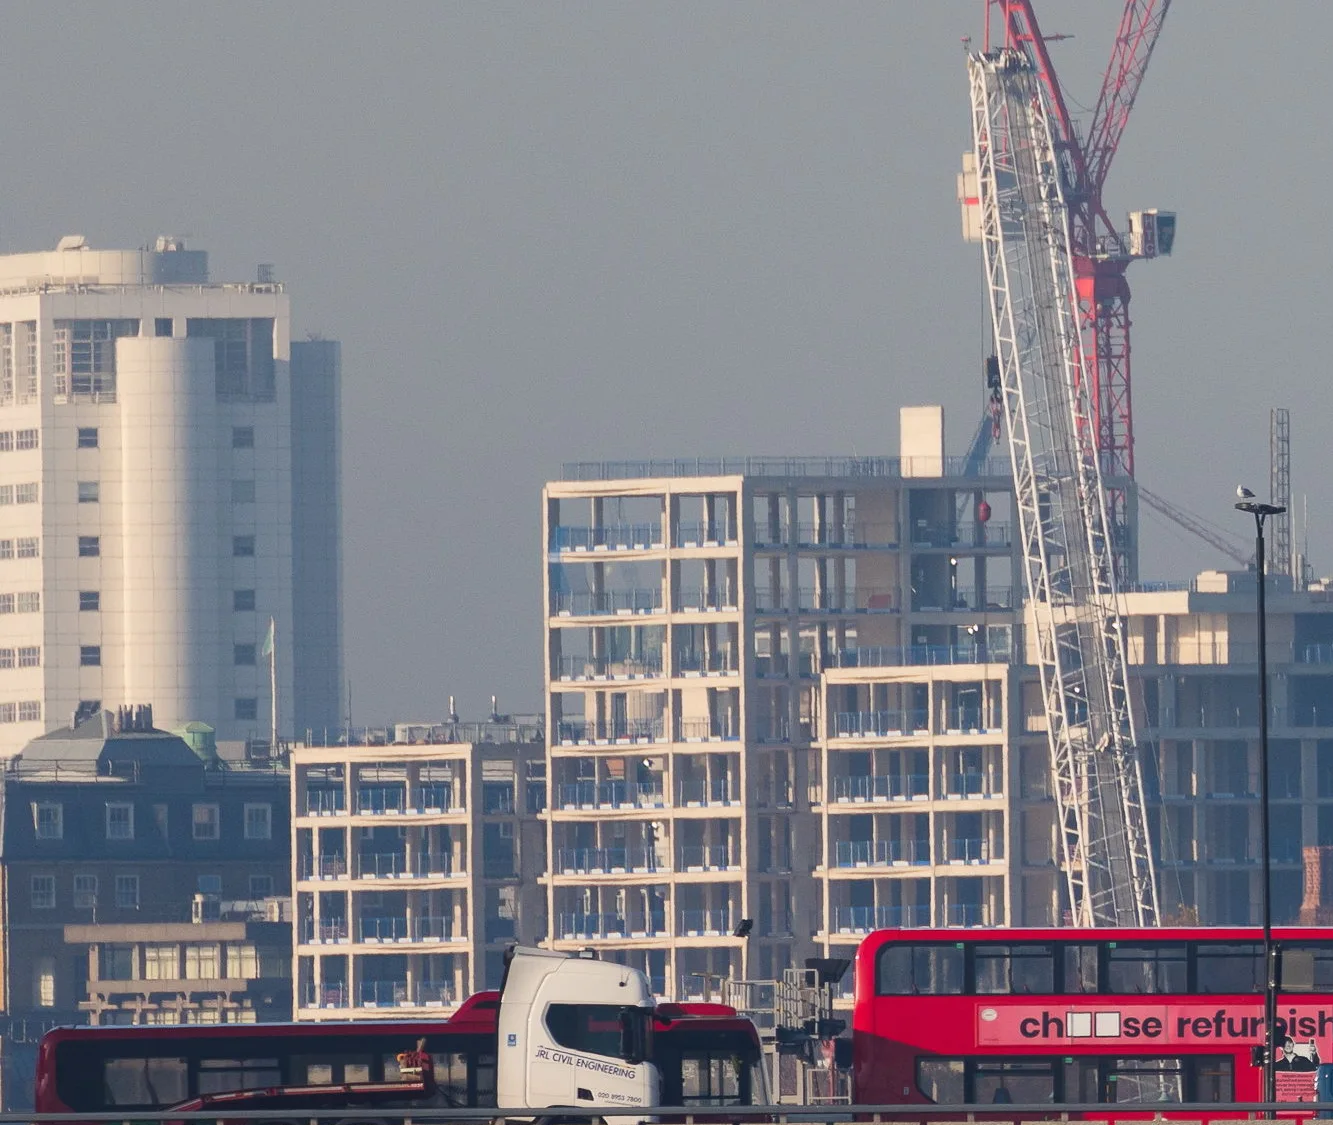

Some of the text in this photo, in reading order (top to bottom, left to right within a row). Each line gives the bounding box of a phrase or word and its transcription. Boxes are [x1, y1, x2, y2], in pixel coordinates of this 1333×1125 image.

[535, 1049, 636, 1079] JRL CIVIL ENGINEERING
